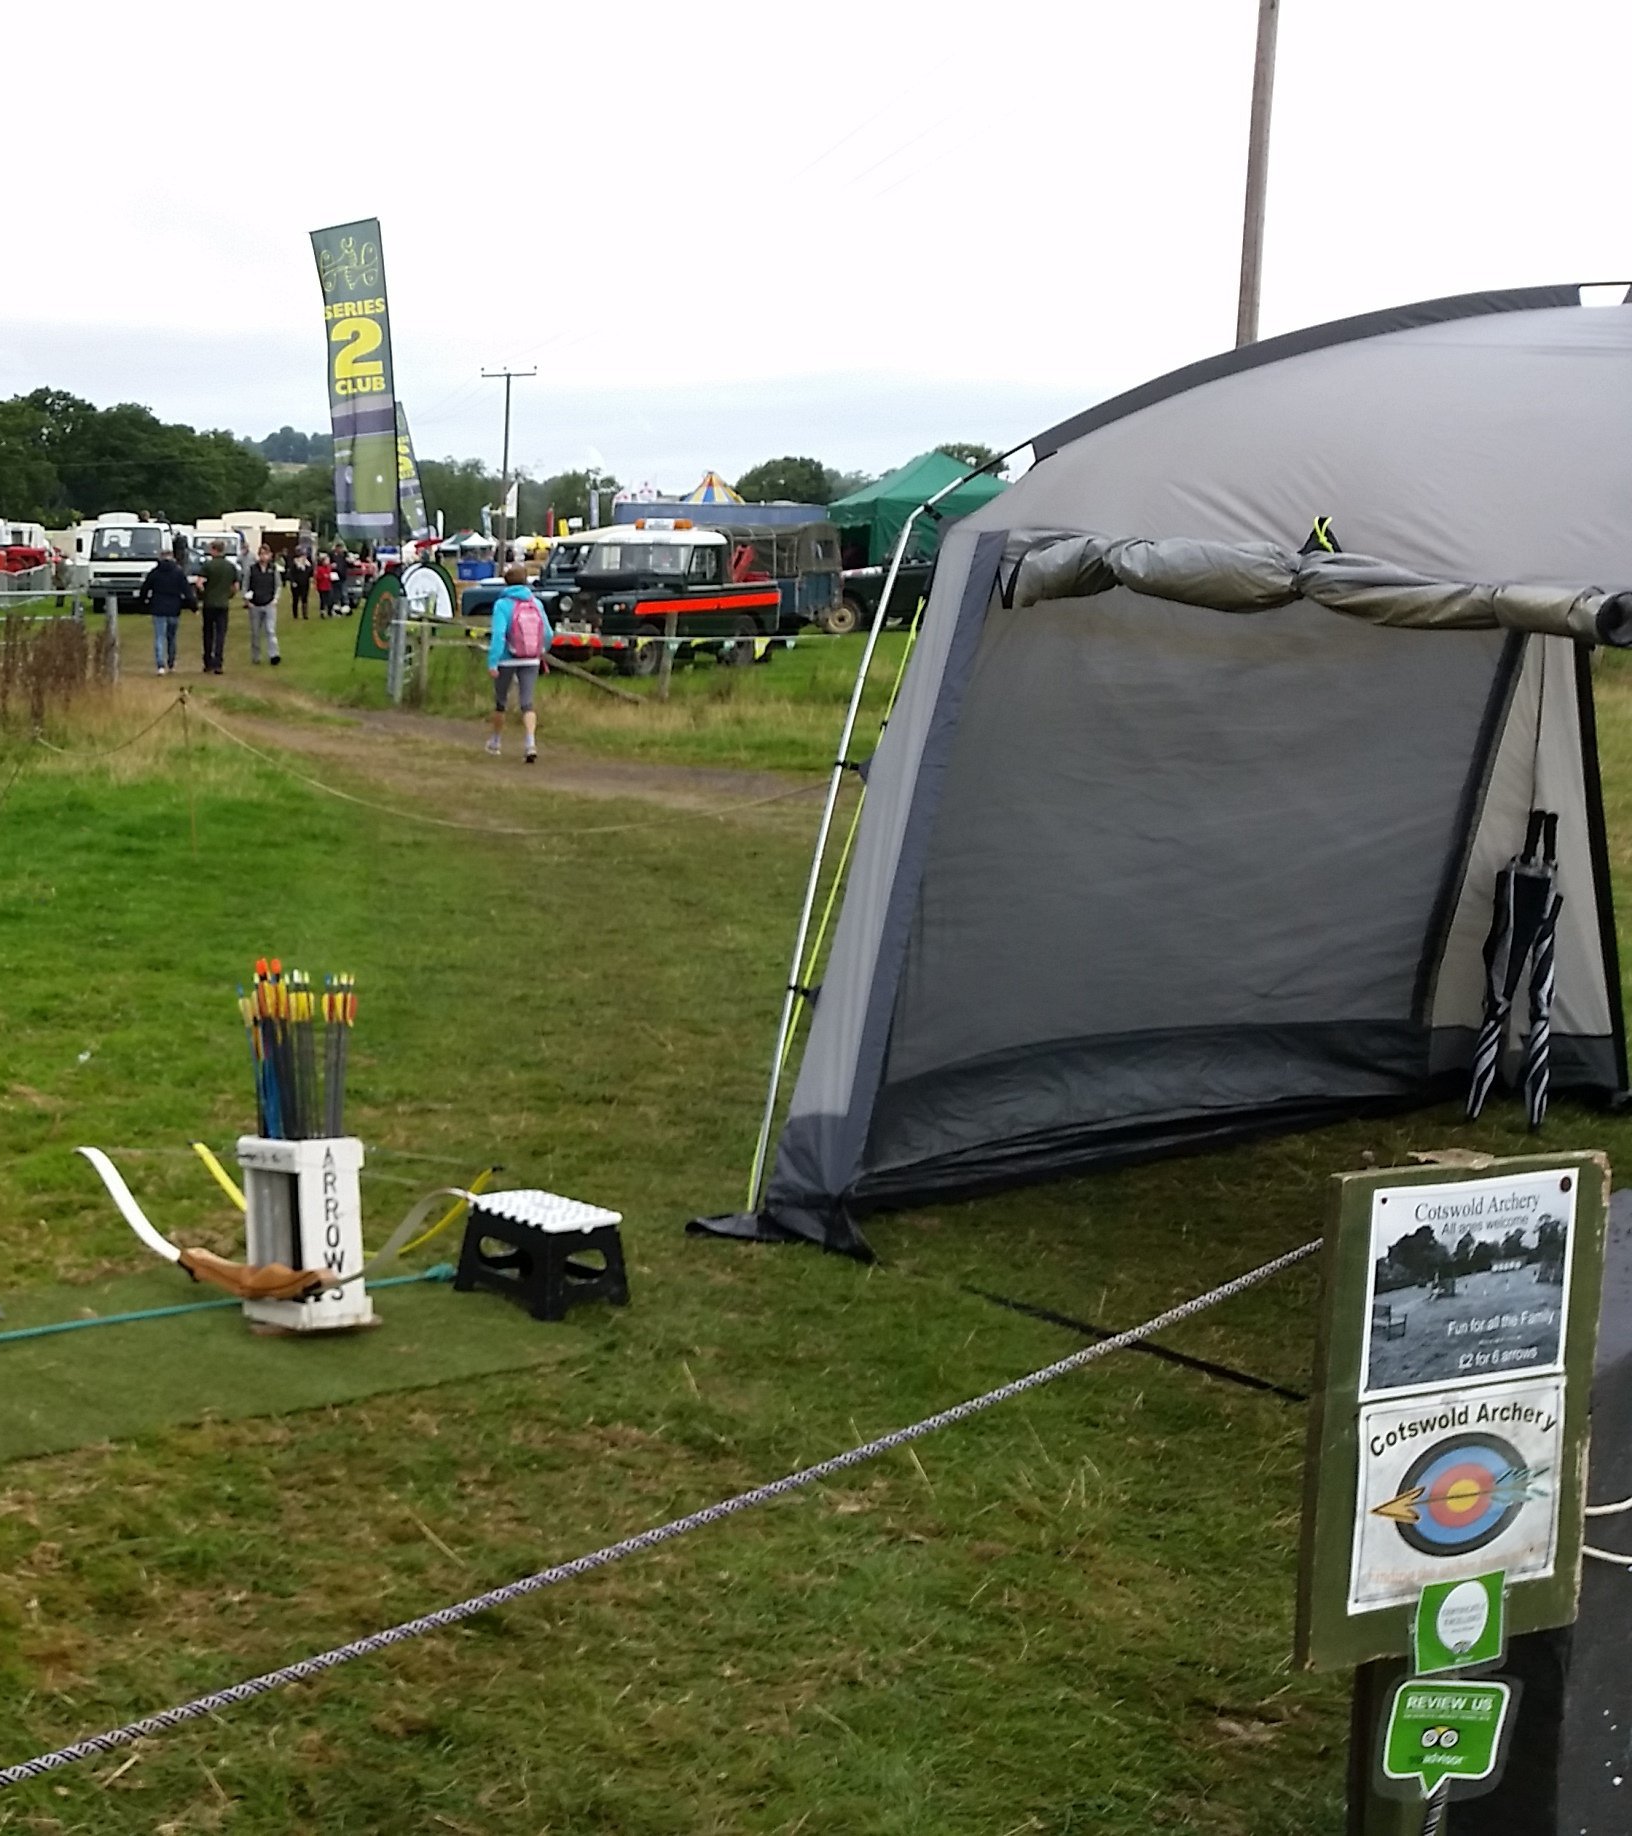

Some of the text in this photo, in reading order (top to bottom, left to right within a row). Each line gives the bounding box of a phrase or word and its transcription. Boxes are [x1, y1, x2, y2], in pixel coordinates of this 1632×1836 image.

[324, 298, 385, 320] SERIES
[331, 316, 383, 379] 2
[335, 376, 385, 395] CLUB
[1415, 1191, 1540, 1222] Cotswold Archery
[1442, 1222, 1456, 1235] All
[1485, 1215, 1529, 1229] welcome
[1448, 1320, 1468, 1336] Fun
[1470, 1317, 1485, 1333] for
[1487, 1315, 1500, 1331] all
[1520, 1310, 1555, 1325] Family
[1458, 1353, 1474, 1369] £2
[1475, 1351, 1490, 1366] for
[1501, 1346, 1538, 1362] arrows
[1370, 1402, 1557, 1457] Cotswold Archery
[1406, 1696, 1494, 1711] REVIEW US
